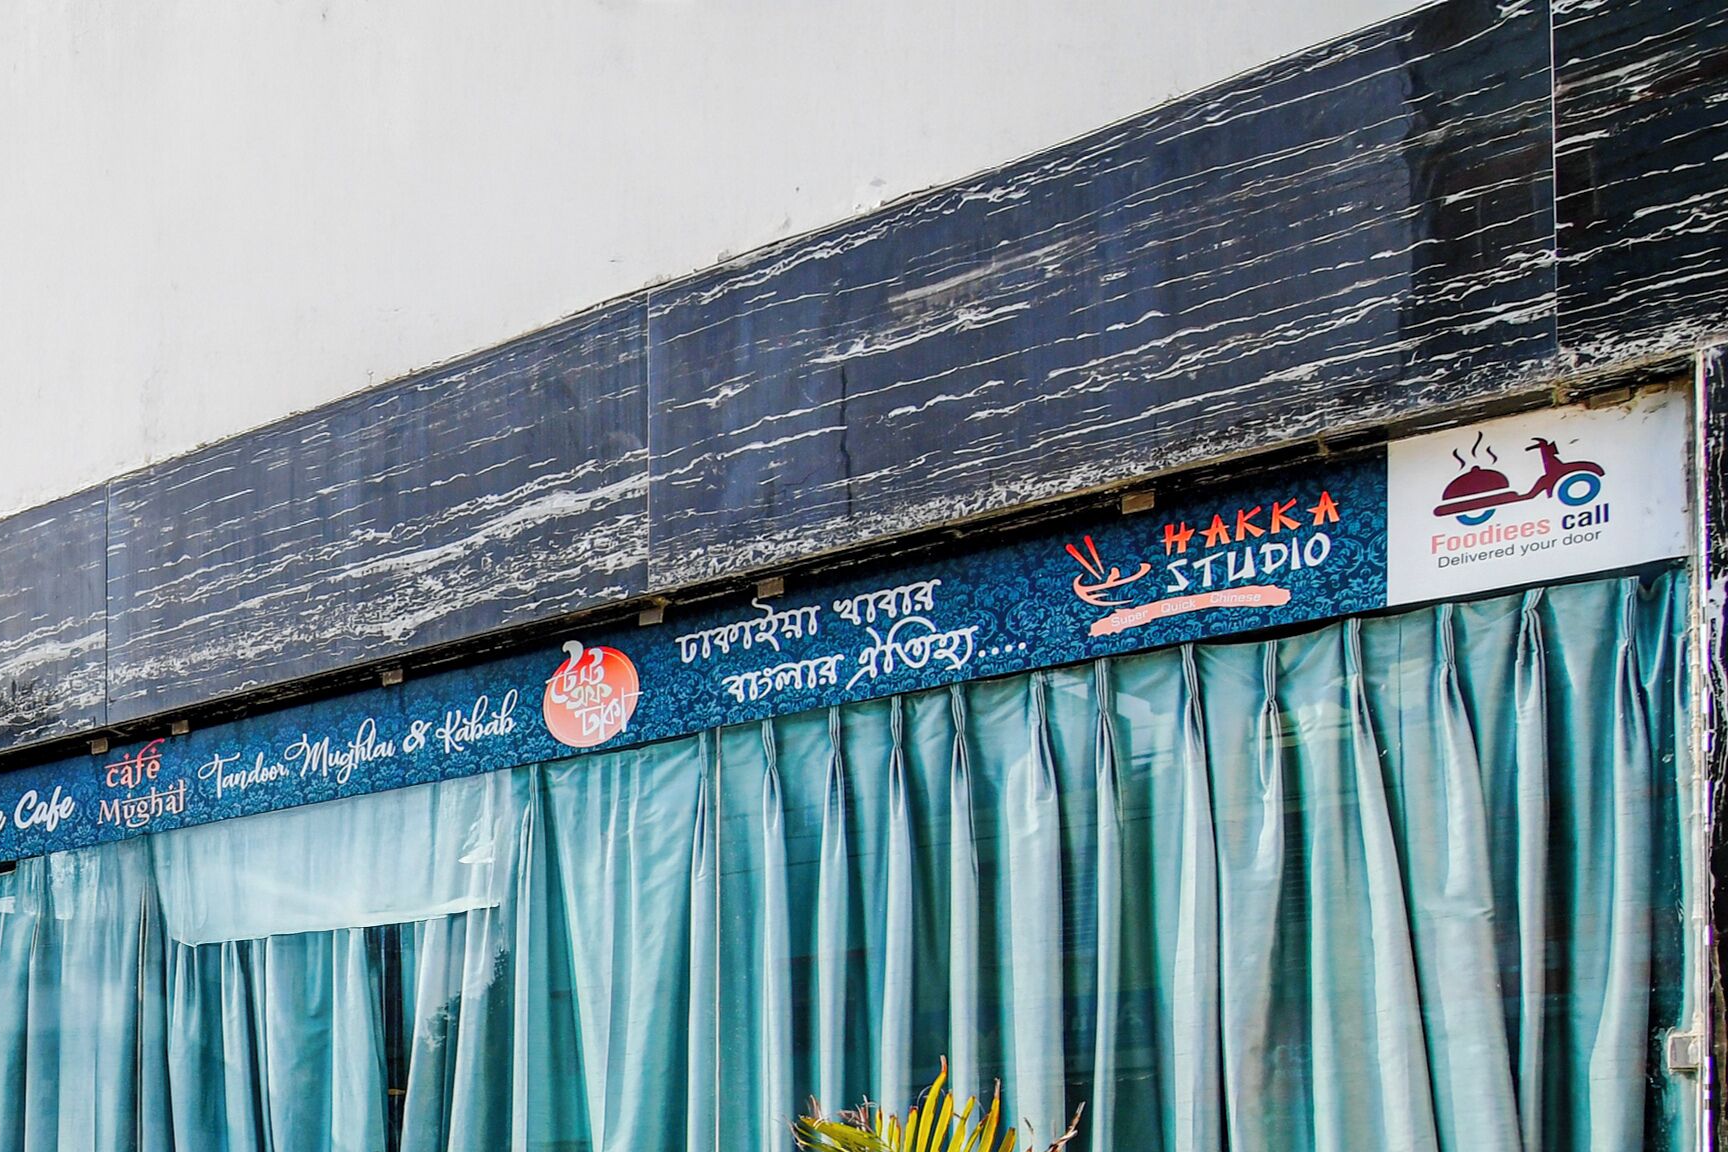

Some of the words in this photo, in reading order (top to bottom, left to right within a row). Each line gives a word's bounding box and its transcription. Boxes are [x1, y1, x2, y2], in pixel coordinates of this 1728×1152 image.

[1160, 490, 1341, 556] HAKKA
[1431, 518, 1552, 555] Foodiees
[1561, 503, 1610, 531] call
[1166, 532, 1332, 593] STUDIO
[1438, 543, 1515, 569] Delivered
[1521, 537, 1558, 556] your
[1562, 530, 1602, 546] door
[833, 578, 942, 626] খাবার
[1110, 608, 1149, 628] Super
[1160, 597, 1197, 616] Quick
[1209, 591, 1262, 605] Chinese
[722, 653, 845, 703] বাংলার
[402, 719, 433, 754] &
[435, 688, 519, 754] Kabab
[14, 785, 74, 832] Cafe
[97, 778, 187, 828] Mughal
